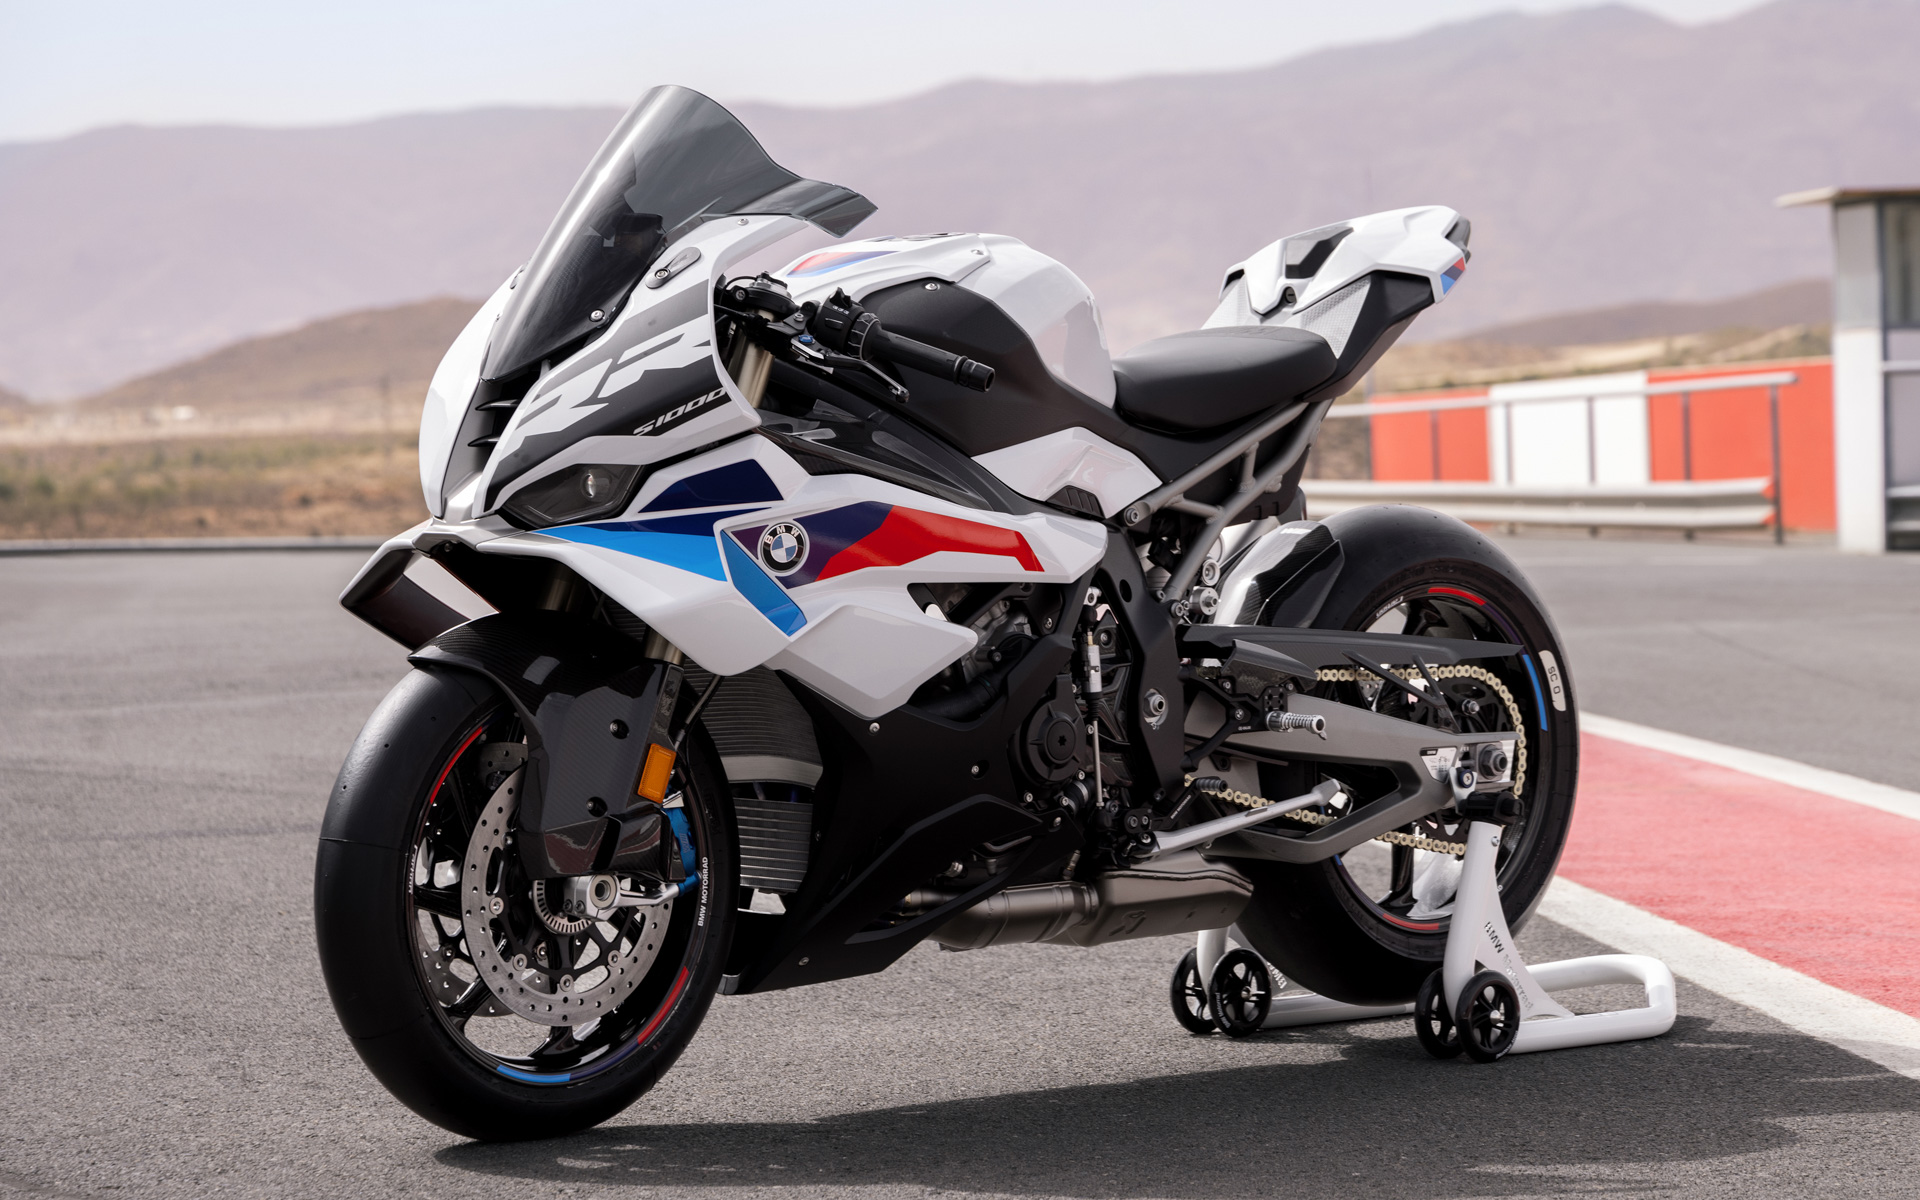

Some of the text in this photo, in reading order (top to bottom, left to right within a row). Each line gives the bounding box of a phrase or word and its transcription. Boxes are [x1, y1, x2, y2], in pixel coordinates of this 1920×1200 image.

[633, 387, 727, 436] S1000
[764, 525, 801, 544] BMW
[1547, 666, 1558, 682] SC
[698, 856, 709, 927] BMW MOTORRAD
[1484, 921, 1504, 953] BMW
